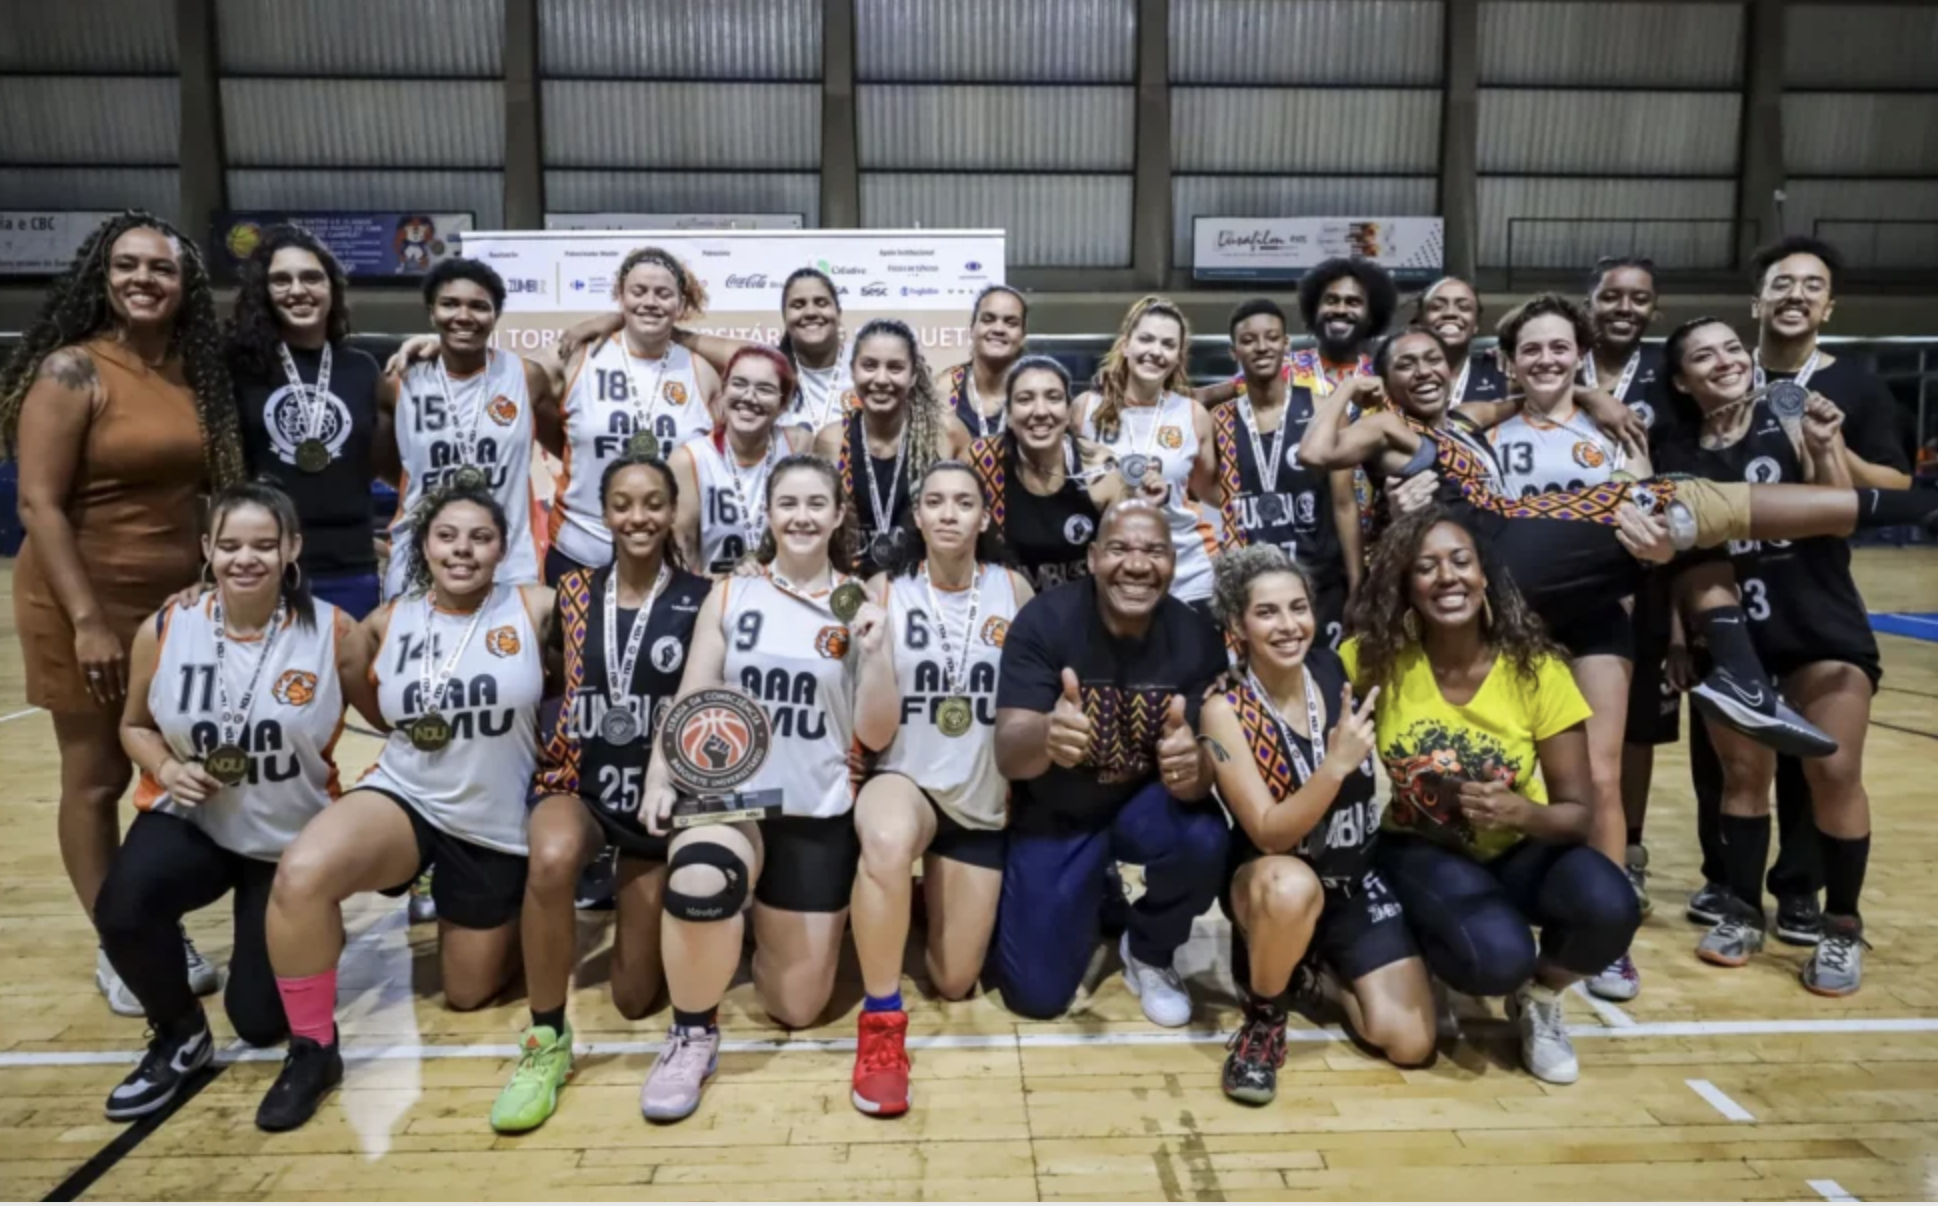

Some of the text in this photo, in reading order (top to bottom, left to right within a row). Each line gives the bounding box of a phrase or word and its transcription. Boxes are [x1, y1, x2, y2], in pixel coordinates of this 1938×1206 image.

[31, 215, 55, 230] CBC
[596, 367, 629, 402] 18
[412, 395, 447, 434] 15
[1501, 441, 1534, 476] 13
[708, 486, 739, 526] 16
[735, 609, 764, 652] 9
[905, 608, 930, 650] 6
[178, 664, 217, 714] 11
[413, 725, 448, 742] NDU
[208, 758, 246, 773] NDU
[599, 765, 643, 813] 25
